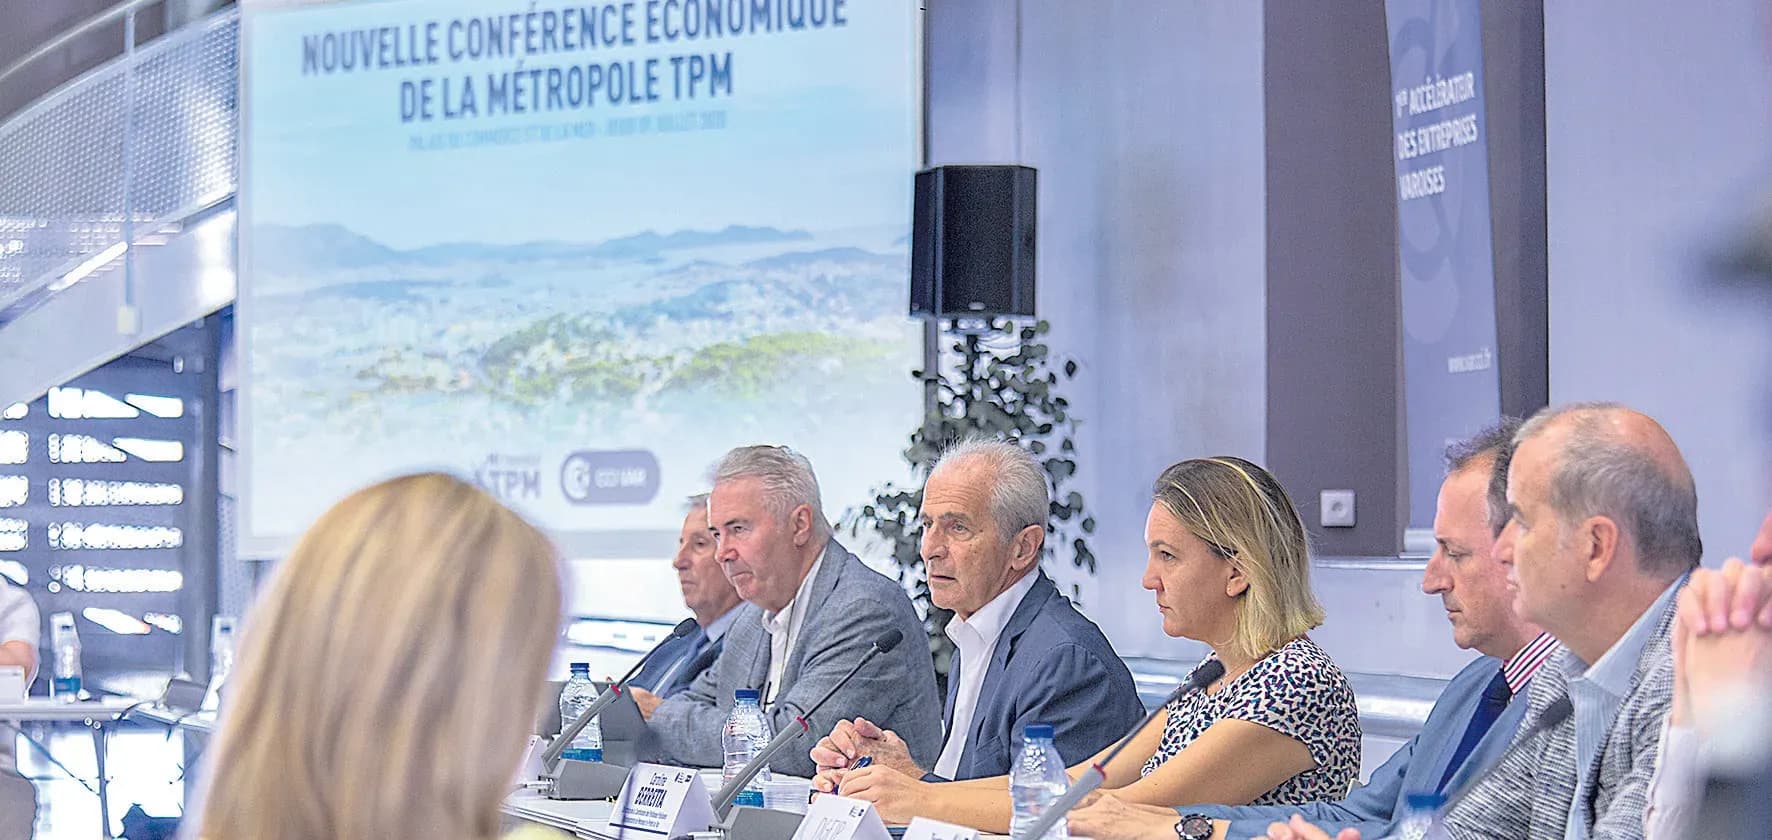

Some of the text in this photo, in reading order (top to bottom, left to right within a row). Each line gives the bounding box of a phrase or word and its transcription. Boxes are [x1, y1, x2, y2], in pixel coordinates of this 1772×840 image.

[301, 21, 439, 75] NOUVELLE
[448, 1, 635, 63] CONFÉRENCE
[401, 52, 732, 123] DE LA MÉTROPOLE TPM
[1409, 71, 1476, 116] ACCÉLÉRATEUR
[1398, 114, 1478, 161] DES ENTREPRISES
[1400, 165, 1446, 201] VAROISES
